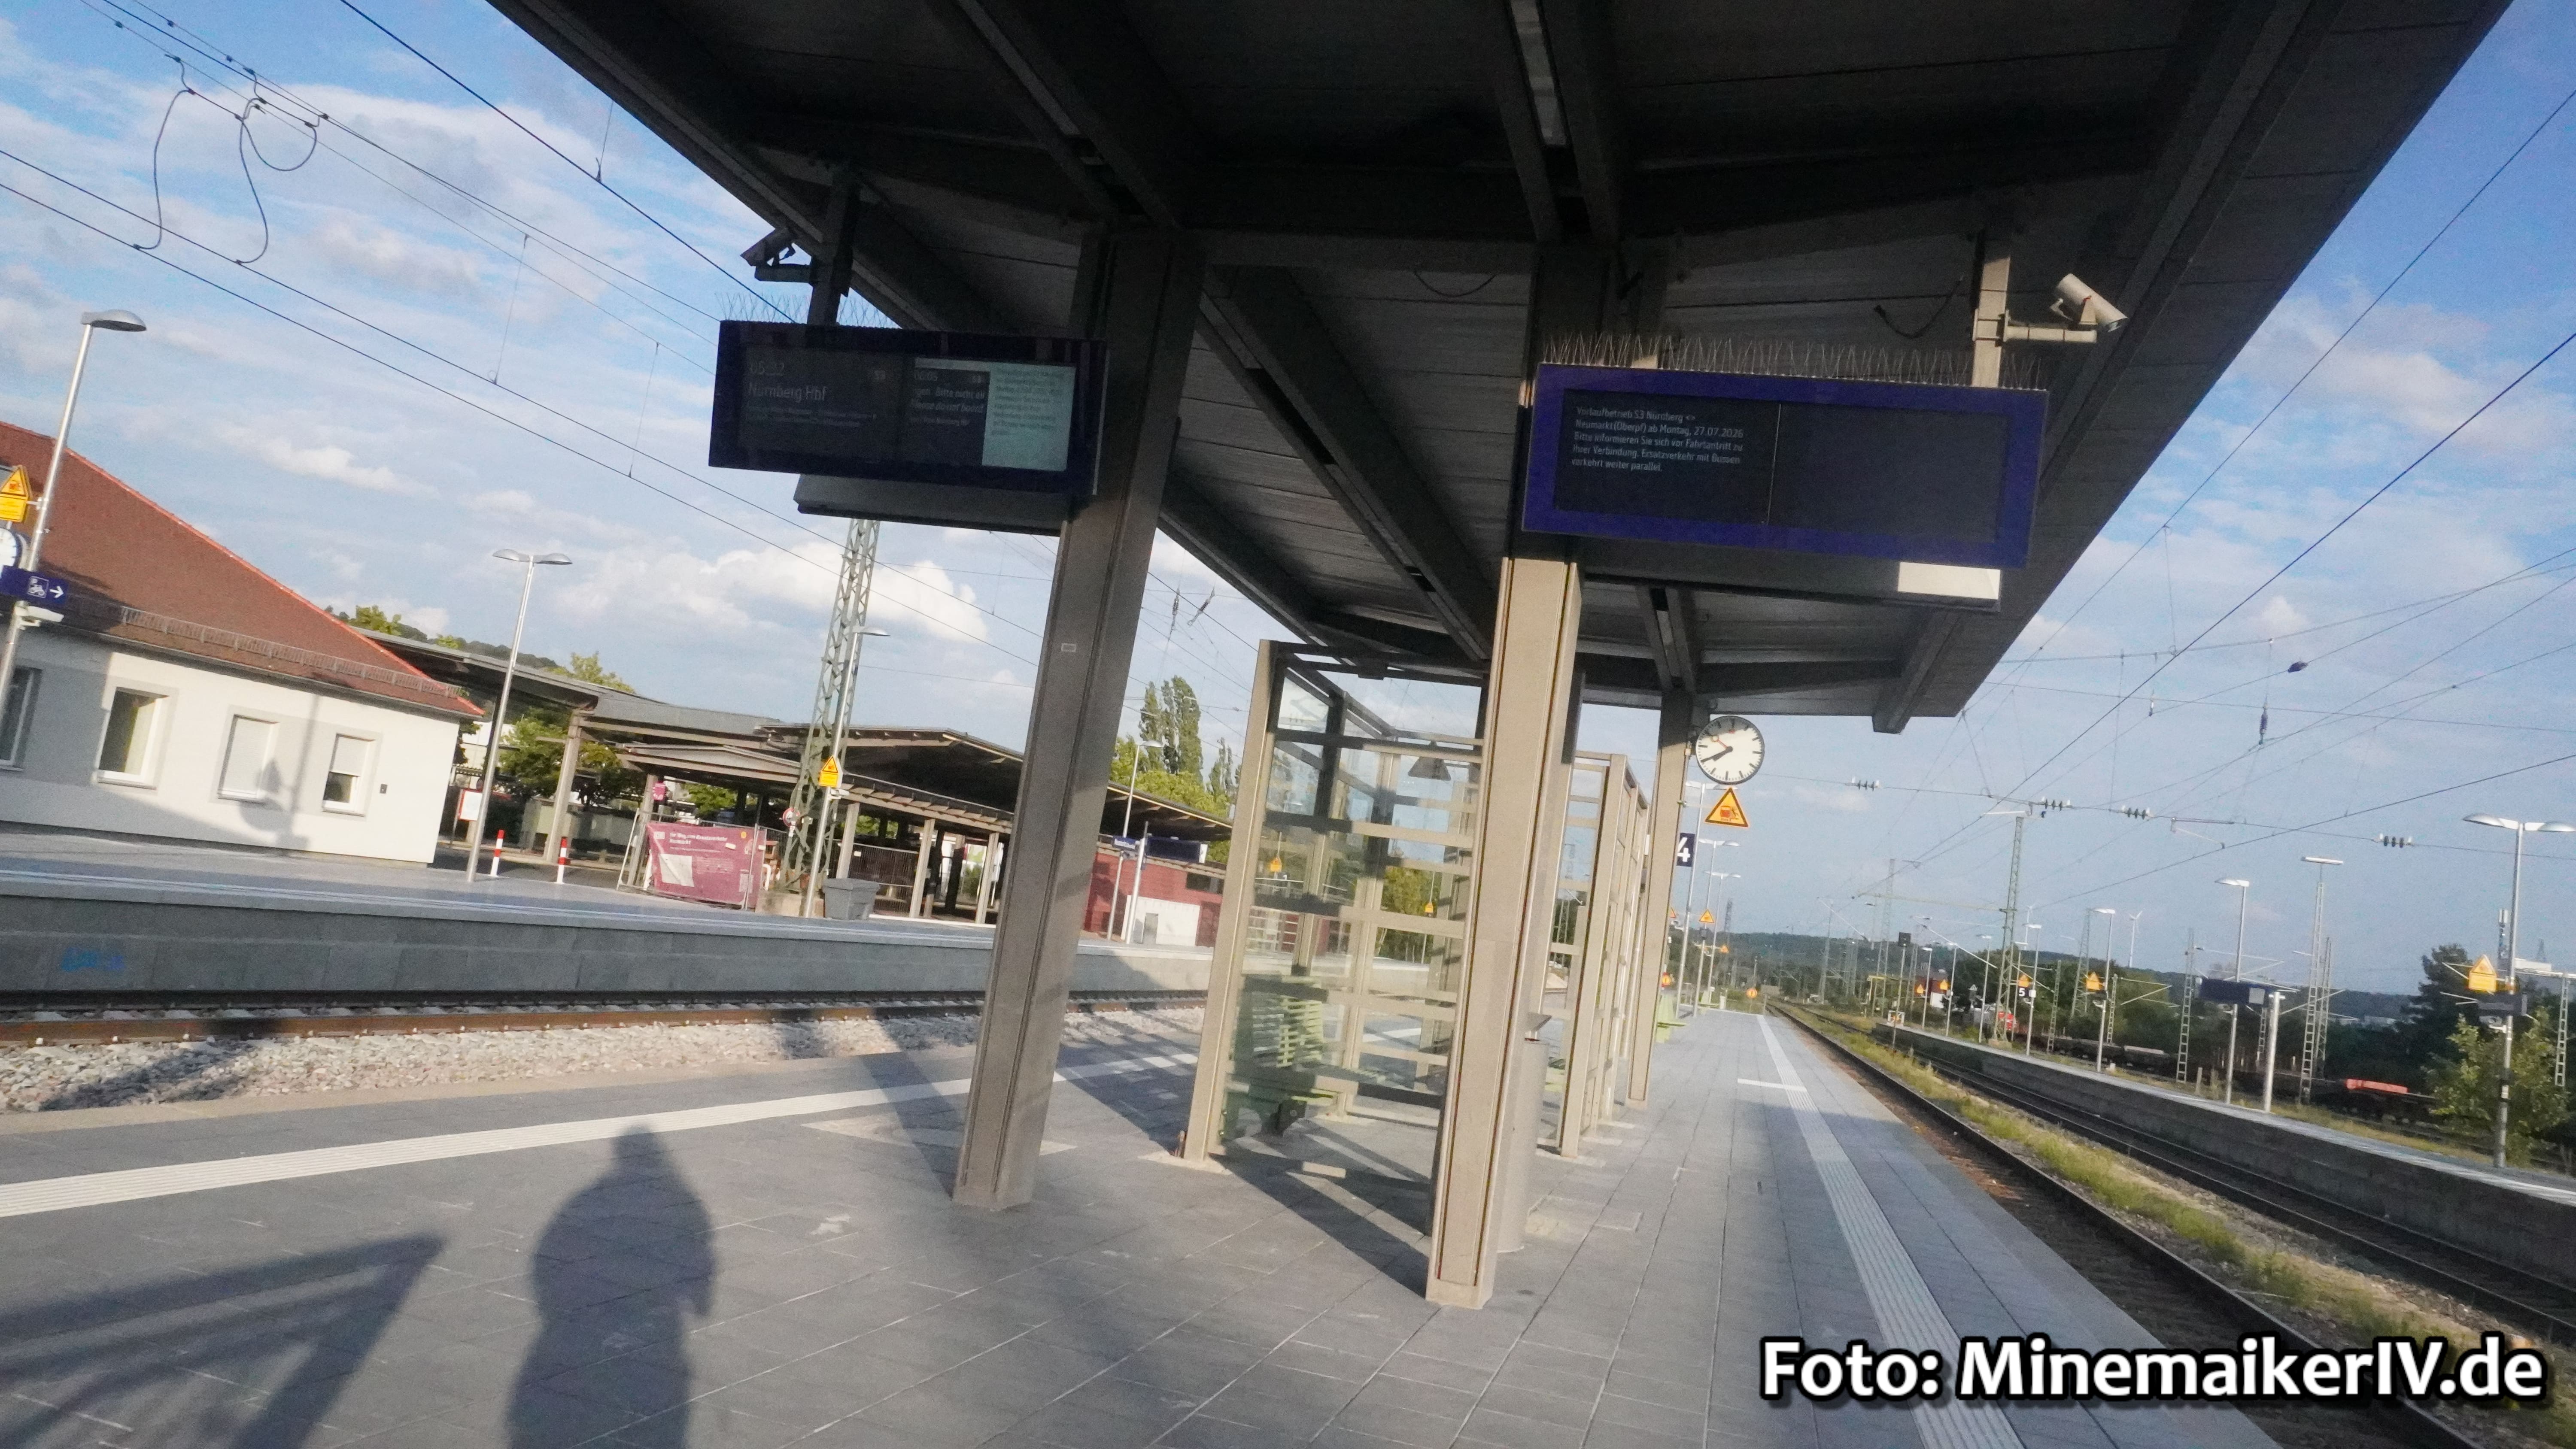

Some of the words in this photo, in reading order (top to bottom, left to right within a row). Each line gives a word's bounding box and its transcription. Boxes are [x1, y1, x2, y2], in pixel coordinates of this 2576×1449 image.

[805, 385, 827, 401] Hbf
[1576, 406, 1632, 418] Vorlaufbetrieb
[1634, 409, 1644, 419] S3
[1646, 410, 1683, 424] Nürnberg
[1648, 424, 1657, 433] ab
[1660, 424, 1692, 437] Montag,
[1694, 426, 1743, 438] 27.07.2026
[1574, 431, 1592, 442] Bitte
[1594, 433, 1639, 444] informieren
[1641, 435, 1652, 445] Sie
[1654, 438, 1669, 446] sich
[1686, 438, 1731, 451] Fahrtantritt
[1573, 444, 1591, 454] Ihrer
[1593, 446, 1639, 458] Verbindung.
[1642, 448, 1694, 461] Ersatzverkehr
[1696, 454, 1709, 462] mit
[1711, 453, 1741, 464] Bussen
[1572, 458, 1604, 467] verkehrt
[1631, 461, 1662, 472] parallel.
[1677, 837, 1690, 862] 4
[2019, 988, 2026, 997] 5
